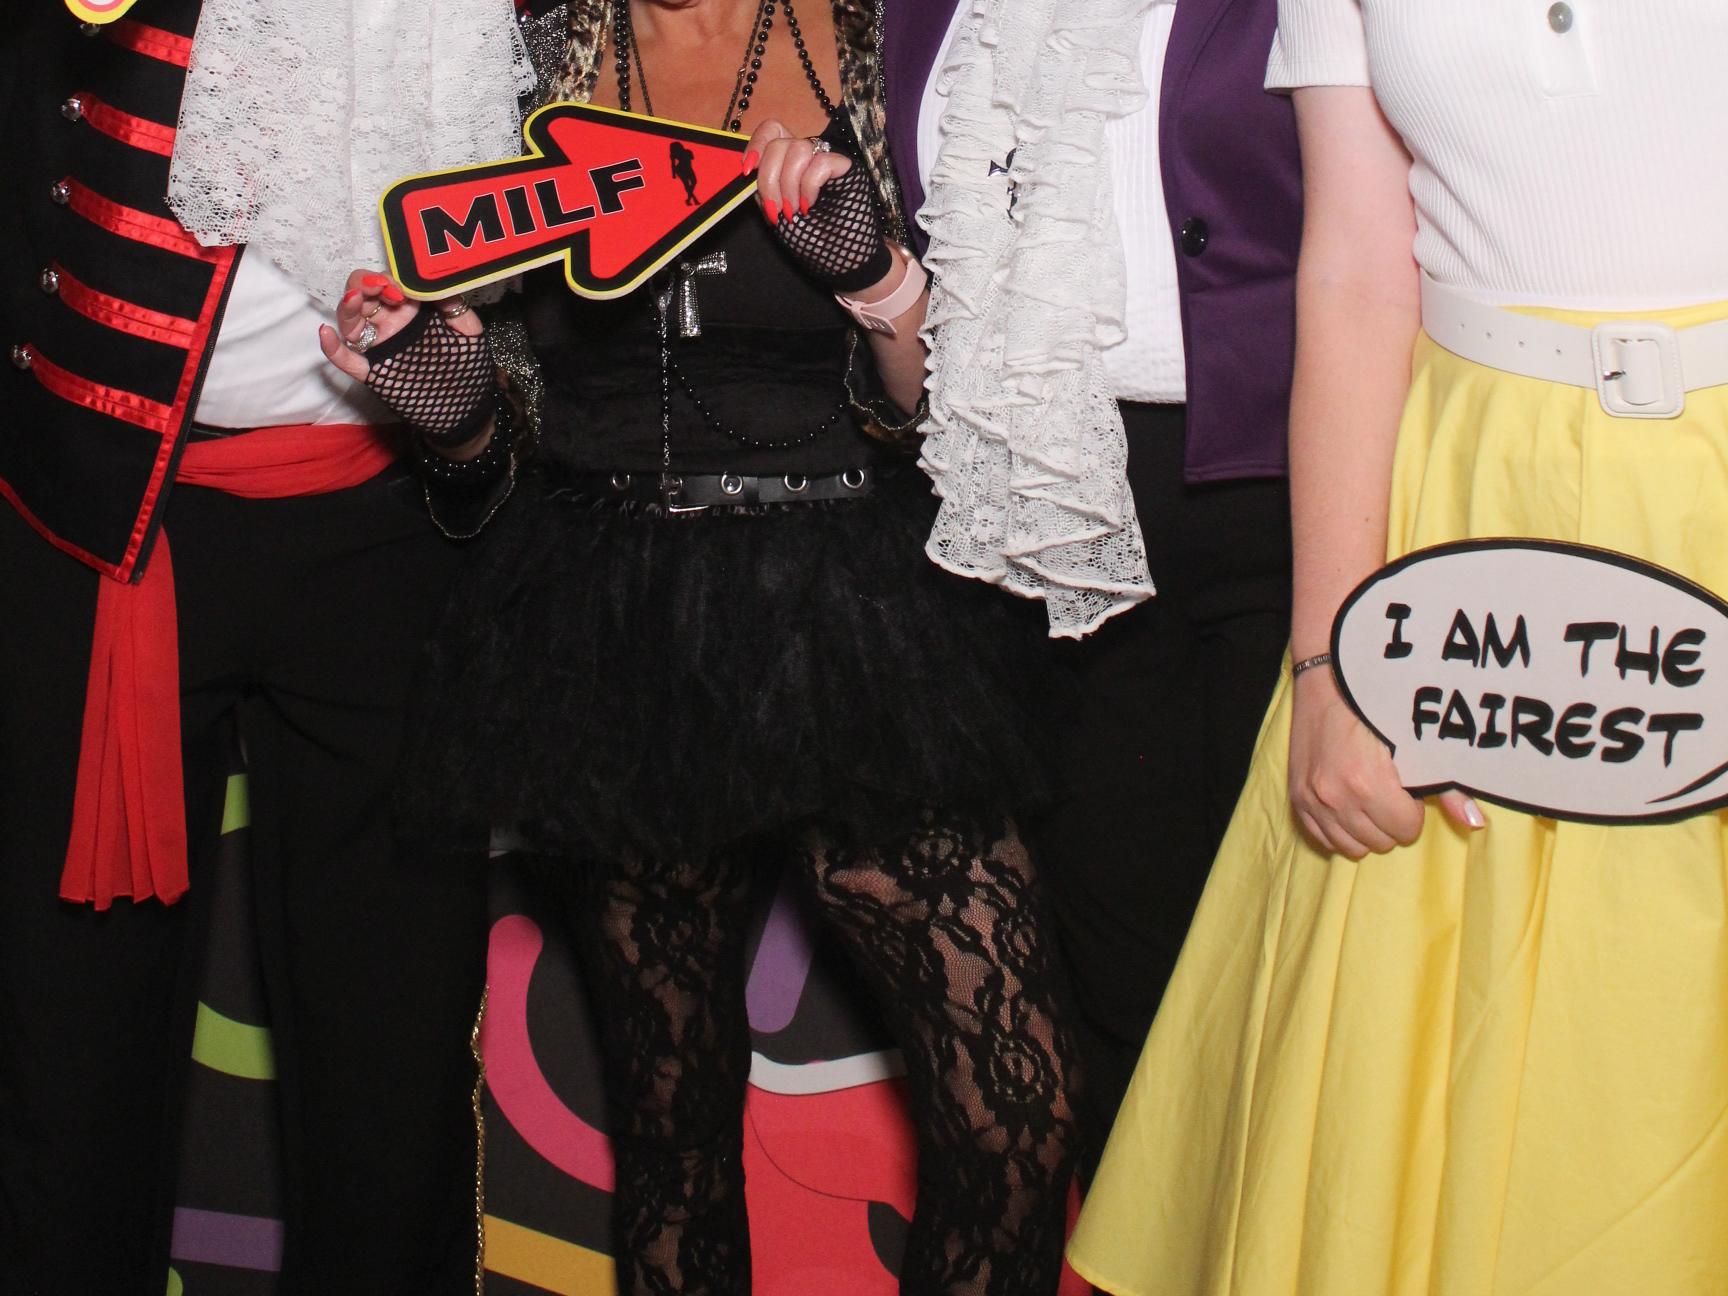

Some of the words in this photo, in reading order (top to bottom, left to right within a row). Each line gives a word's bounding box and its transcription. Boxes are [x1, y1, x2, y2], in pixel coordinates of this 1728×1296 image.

[419, 157, 645, 257] MILF
[1384, 602, 1413, 659] I
[1441, 608, 1531, 669] AM
[1564, 621, 1706, 688] THE
[1412, 685, 1704, 768] FAIREST
